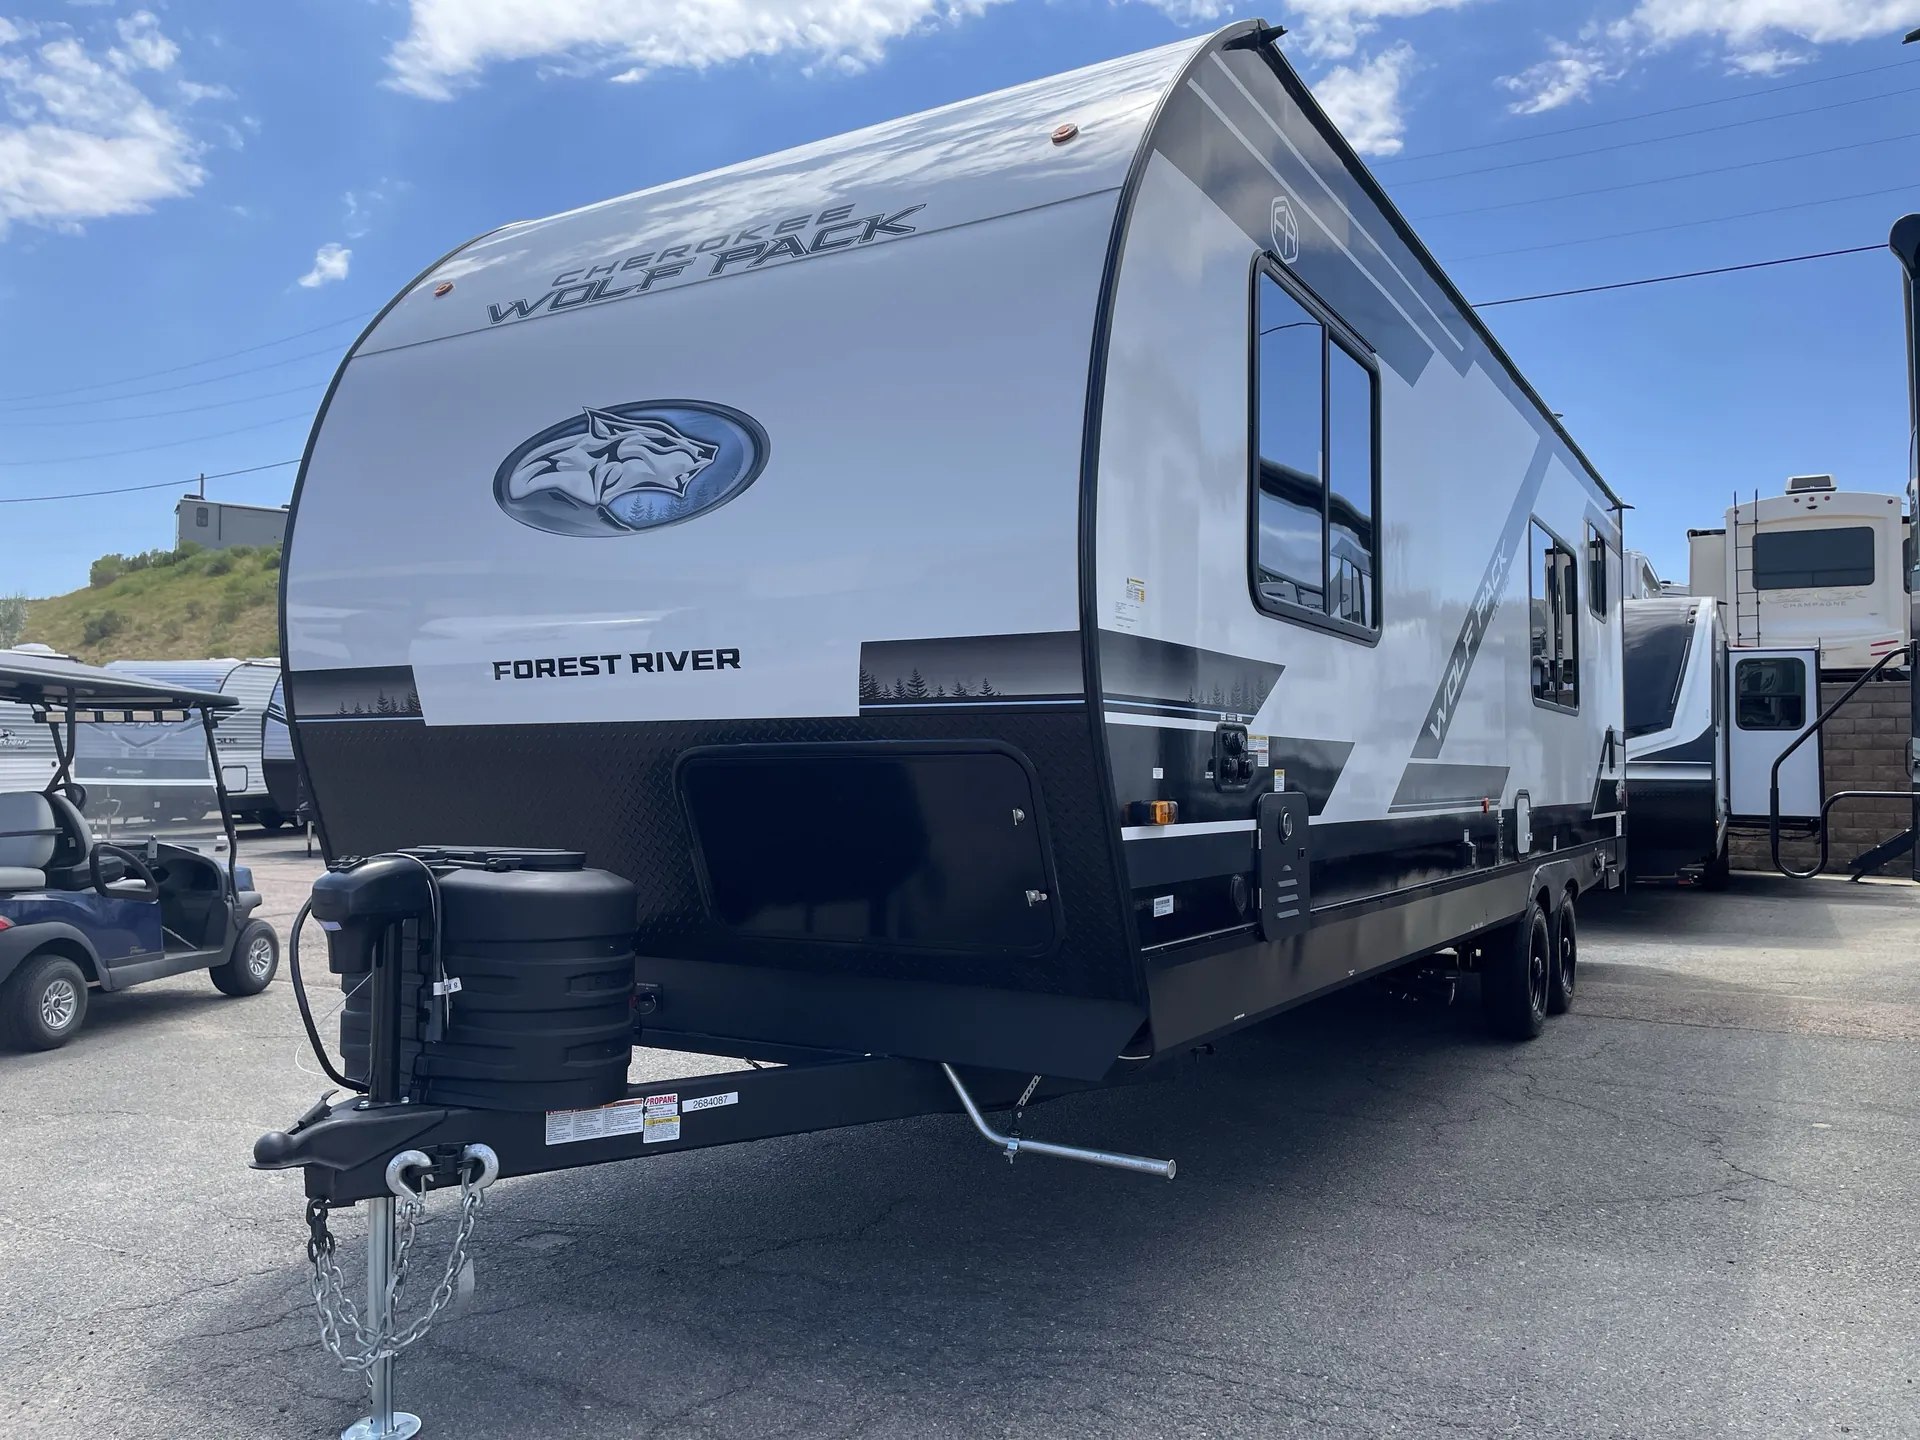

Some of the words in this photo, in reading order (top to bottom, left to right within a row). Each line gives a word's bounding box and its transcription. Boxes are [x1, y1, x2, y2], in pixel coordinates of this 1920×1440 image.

[487, 257, 696, 324] WOLF
[708, 203, 927, 277] PACK
[552, 203, 856, 286] CHEROKEE
[1782, 601, 1847, 609] CHAMPAGNE
[492, 654, 622, 681] FOREST
[629, 648, 741, 673] RIVER
[1430, 619, 1474, 740] WOLF
[1475, 539, 1507, 628] PACK
[693, 1095, 728, 1109] 2684087
